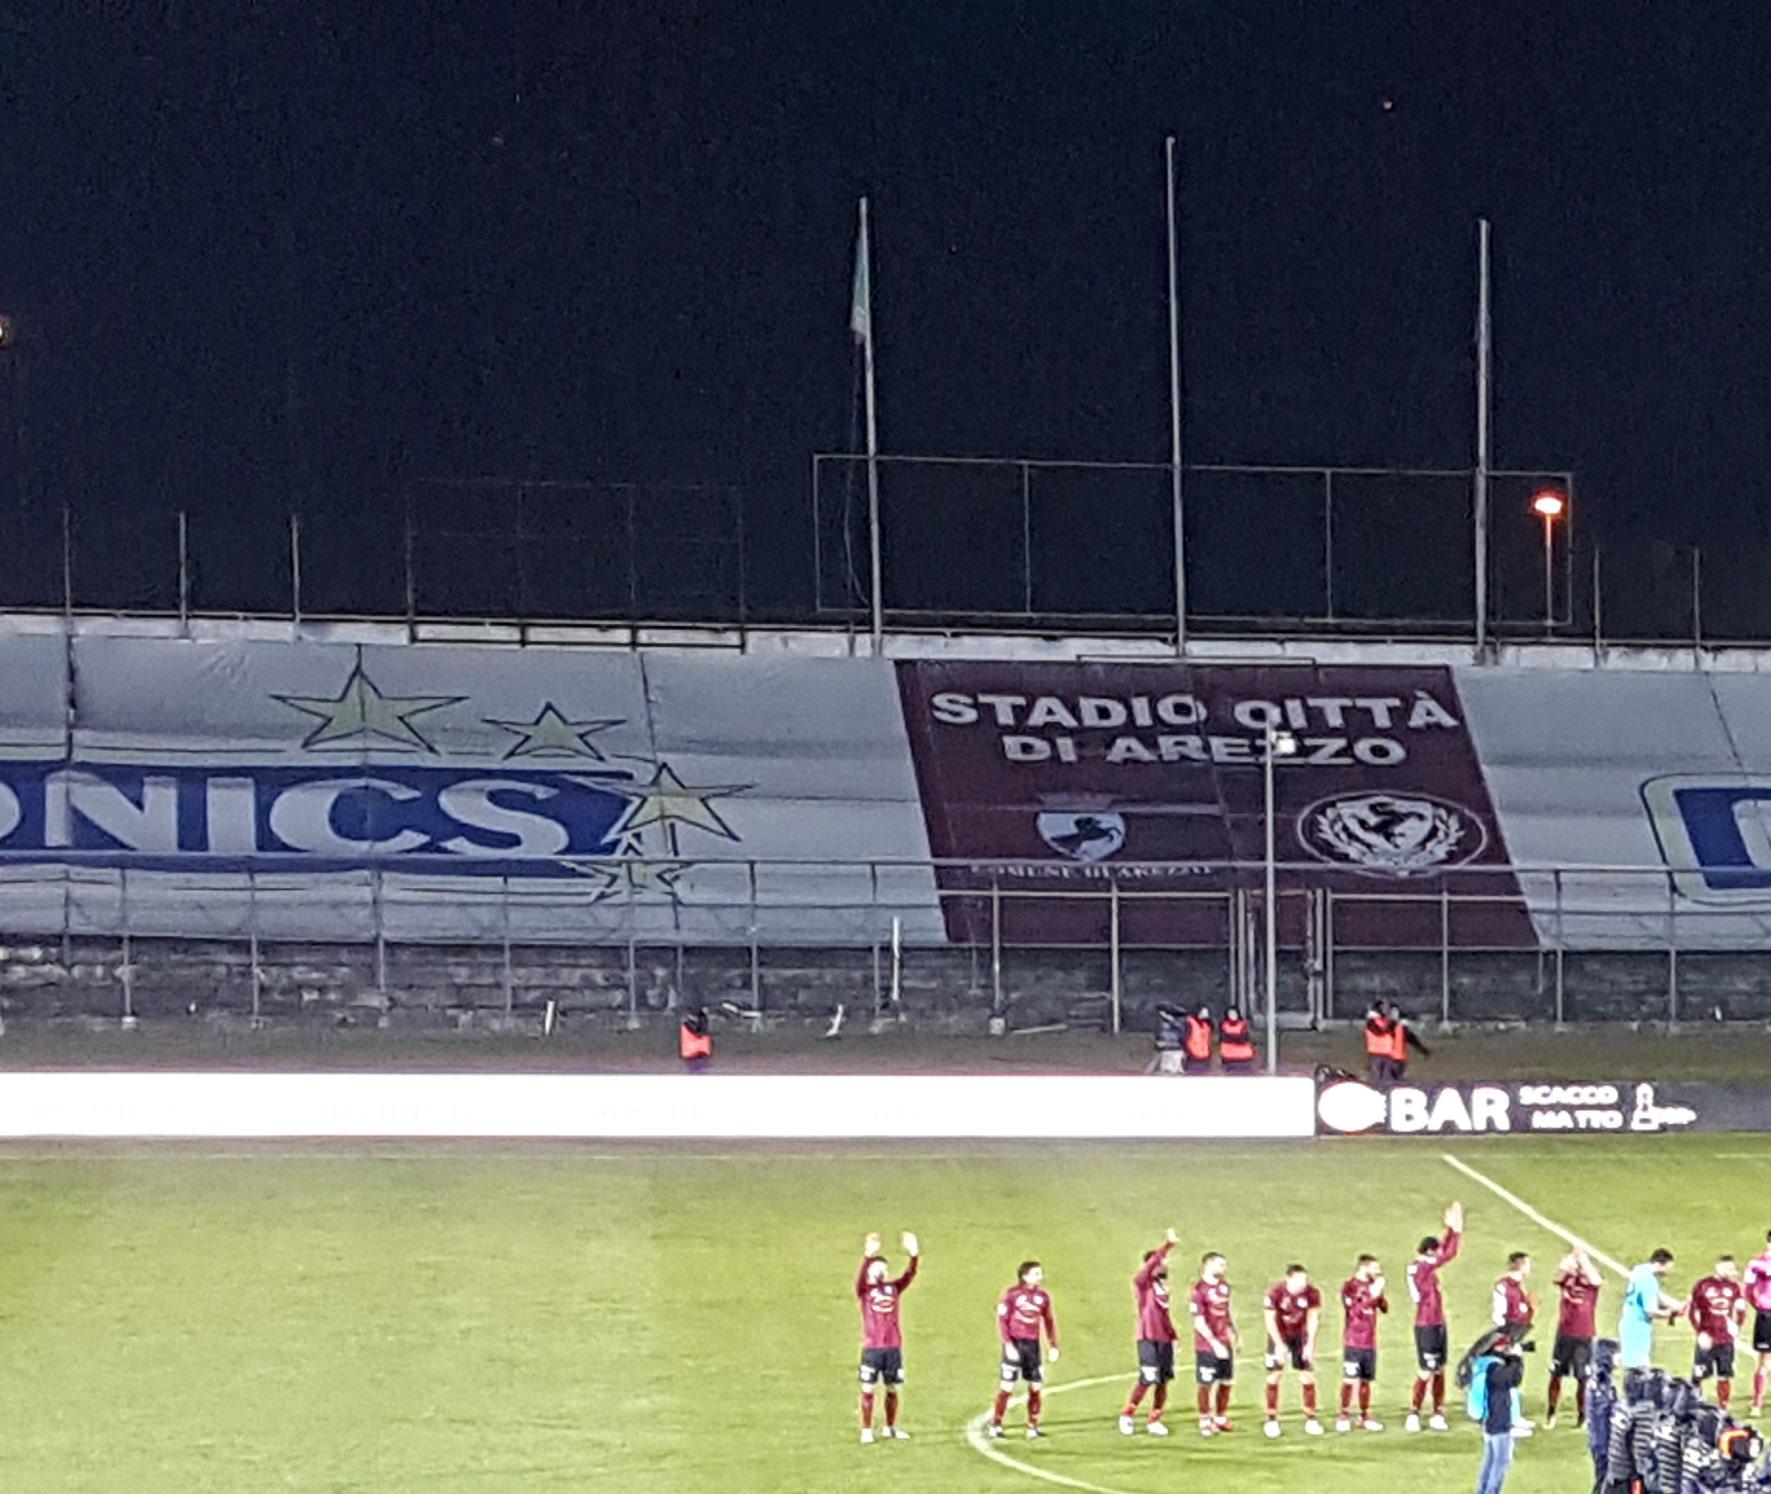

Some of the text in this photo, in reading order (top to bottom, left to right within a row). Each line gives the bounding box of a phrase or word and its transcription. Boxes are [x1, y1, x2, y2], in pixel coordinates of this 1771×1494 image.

[931, 692, 1207, 728] STADIO
[1001, 735, 1408, 767] DI AREZZO
[0, 769, 571, 858] NICS
[1389, 1085, 1510, 1132] BAR
